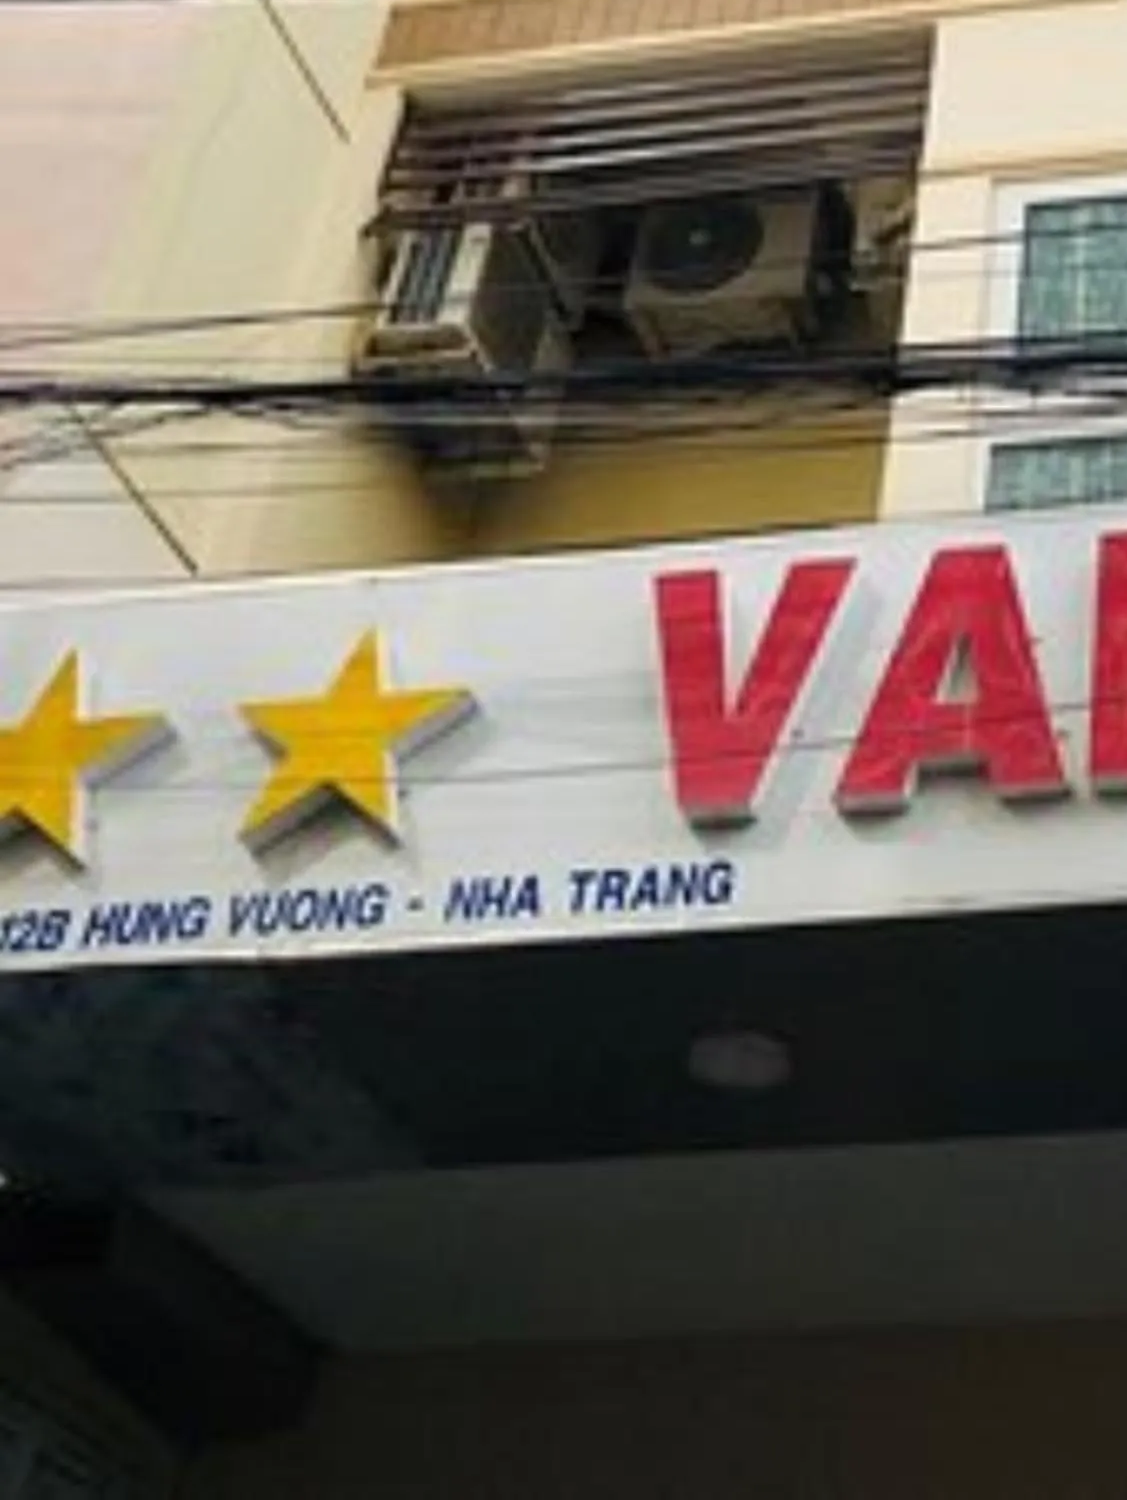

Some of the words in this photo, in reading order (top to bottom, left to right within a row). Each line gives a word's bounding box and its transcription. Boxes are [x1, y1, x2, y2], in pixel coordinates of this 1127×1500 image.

[82, 896, 211, 946] HUNG
[229, 883, 391, 938] VUONG
[444, 874, 540, 922] NHA
[568, 860, 733, 915] TRANG
